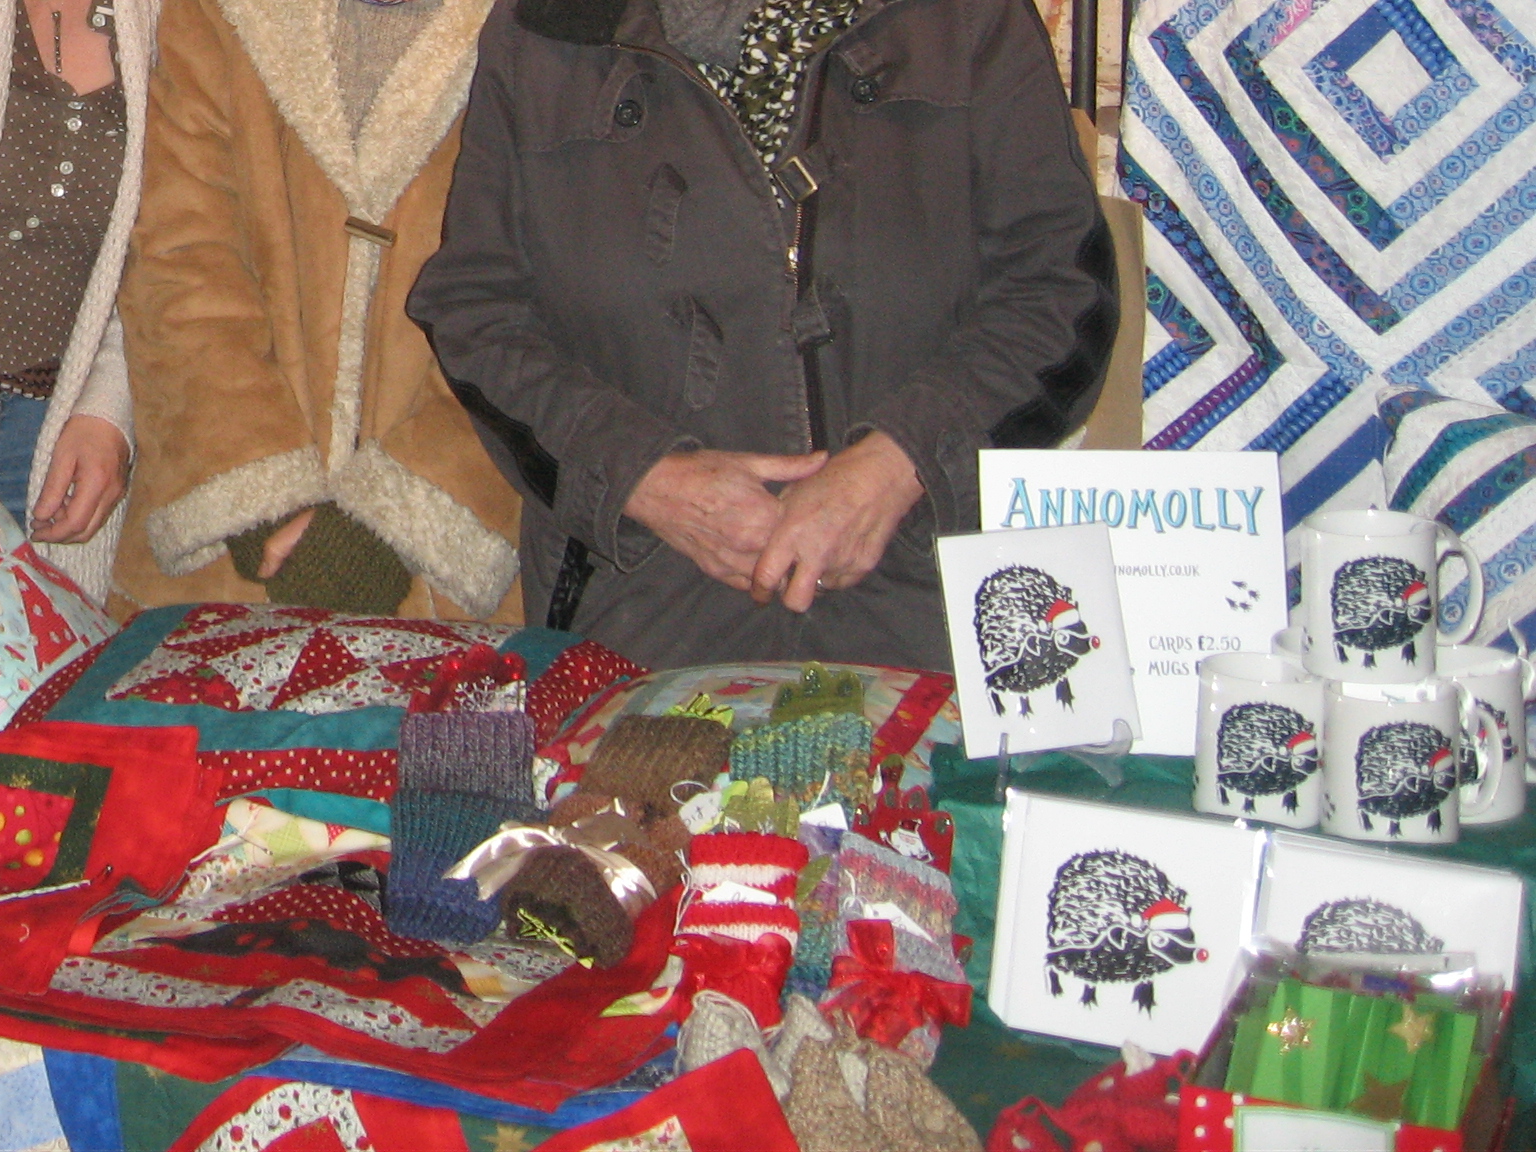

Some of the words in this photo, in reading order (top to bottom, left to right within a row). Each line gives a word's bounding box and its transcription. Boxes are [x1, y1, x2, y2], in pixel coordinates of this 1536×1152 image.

[1000, 477, 1264, 536] ANNOMOLLY
[1148, 635, 1193, 654] CARDS
[1198, 635, 1241, 651] £2.50
[1148, 659, 1190, 676] MUGS
